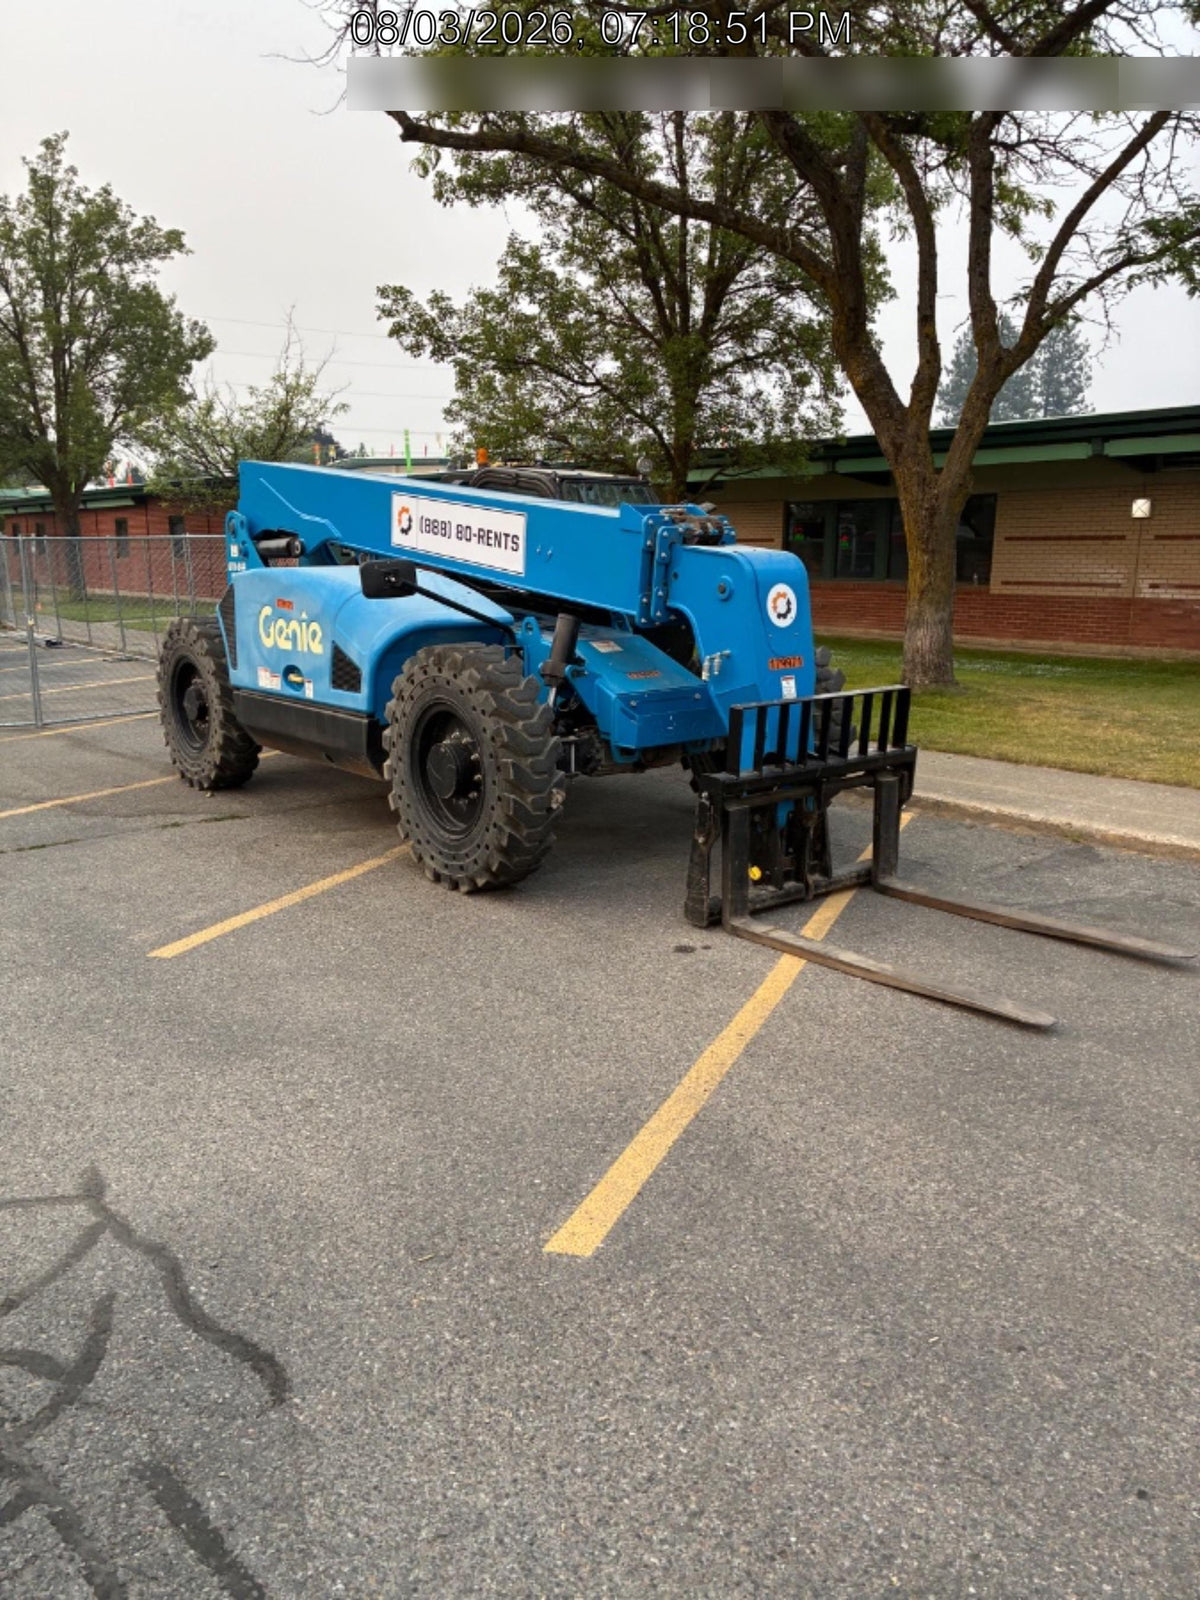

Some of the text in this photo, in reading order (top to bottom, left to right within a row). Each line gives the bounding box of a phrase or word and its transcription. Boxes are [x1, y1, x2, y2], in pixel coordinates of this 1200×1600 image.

[419, 515, 521, 552] (888) 80-RENTS
[258, 605, 324, 655] Genie
